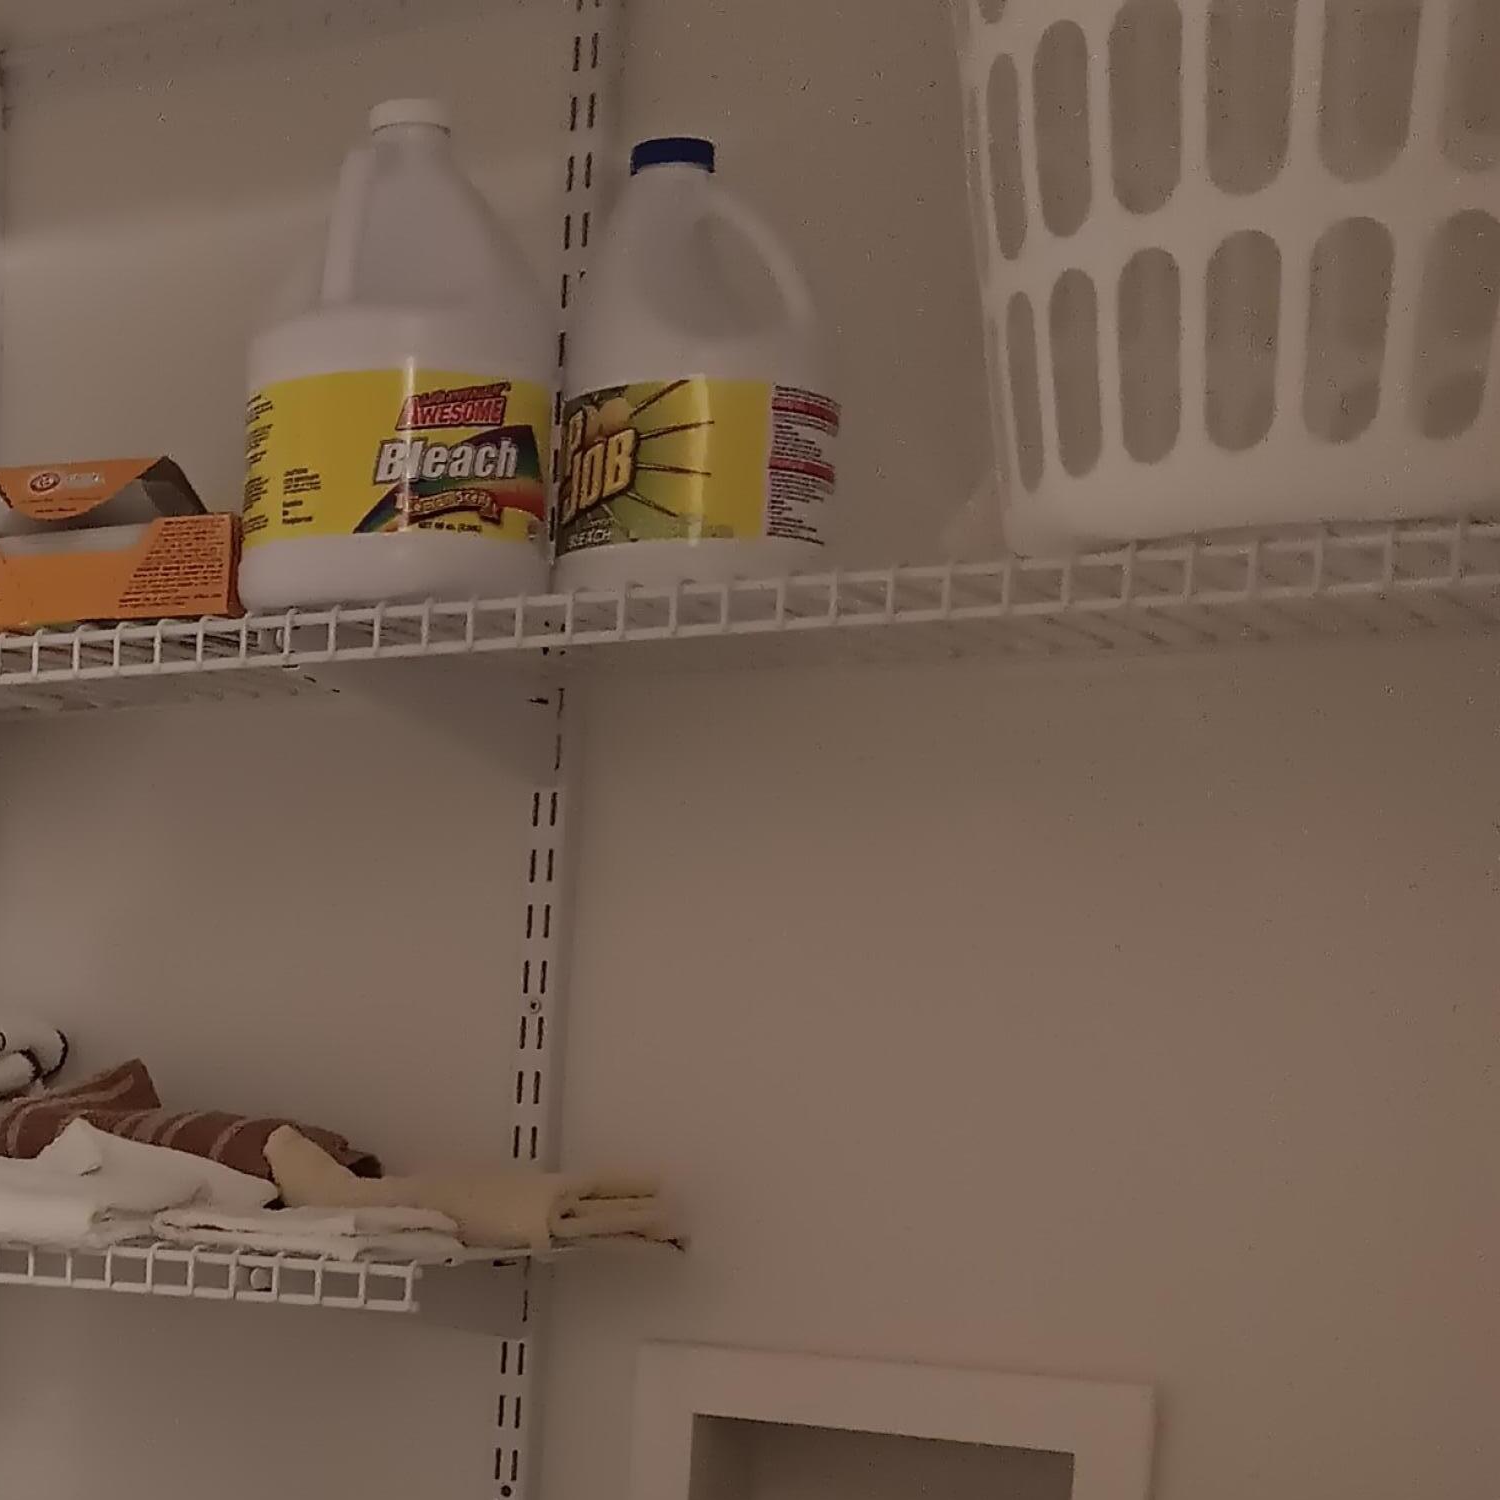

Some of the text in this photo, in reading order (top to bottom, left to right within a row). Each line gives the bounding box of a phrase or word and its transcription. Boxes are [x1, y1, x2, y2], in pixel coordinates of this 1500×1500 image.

[397, 395, 505, 429] AWESOME
[375, 440, 518, 483] Bleach
[561, 428, 635, 524] JOB
